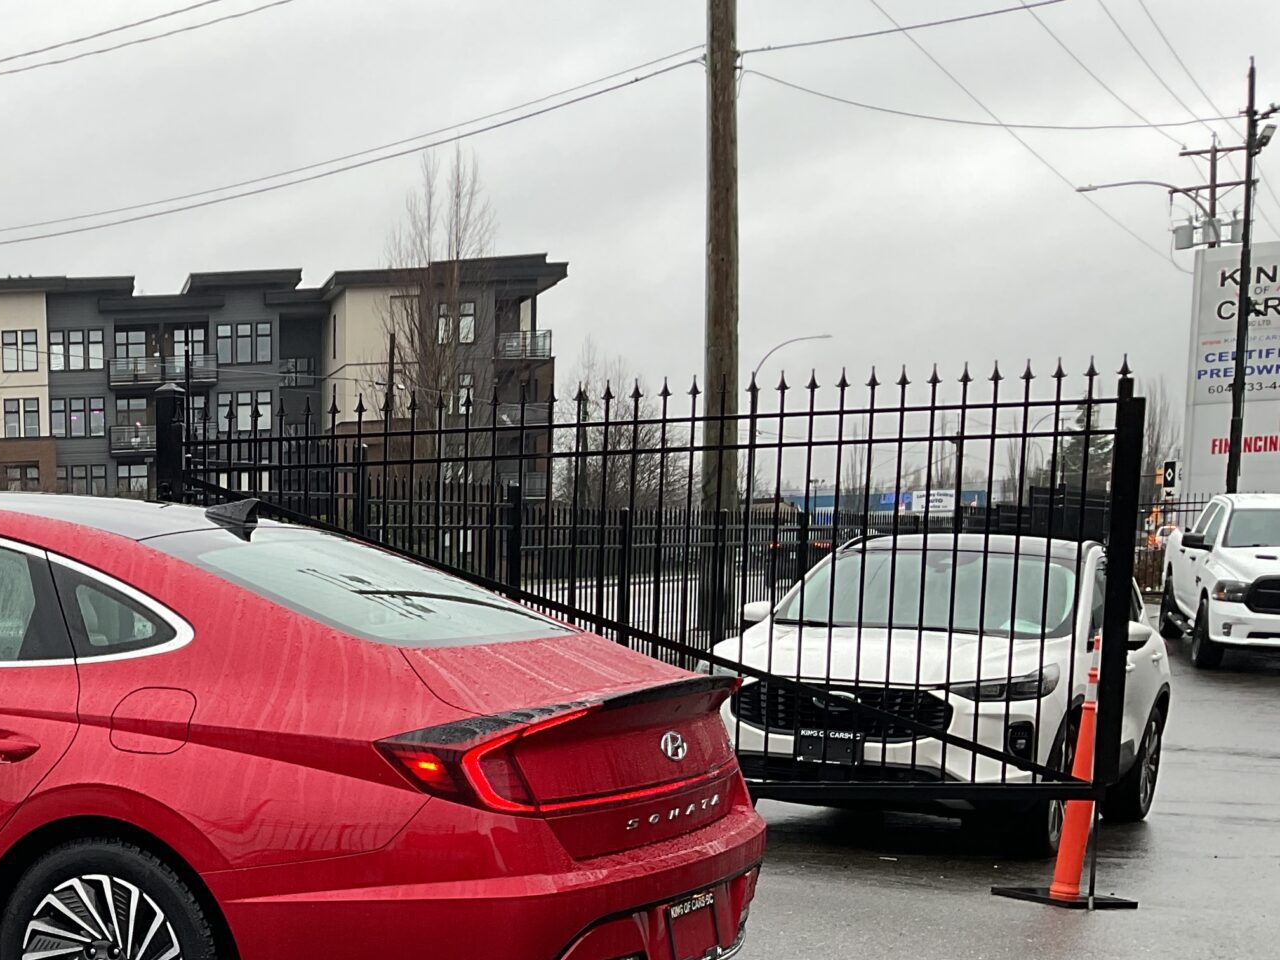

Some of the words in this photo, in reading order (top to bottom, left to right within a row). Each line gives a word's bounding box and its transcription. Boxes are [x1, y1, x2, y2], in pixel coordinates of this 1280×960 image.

[1220, 265, 1278, 287] KN
[1254, 285, 1271, 296] OF
[1216, 297, 1280, 321] CR
[1211, 435, 1280, 455] FINNCIN
[800, 729, 818, 737] KING
[626, 794, 720, 830] SONATA
[670, 904, 684, 918] KING
[683, 901, 691, 913] OF
